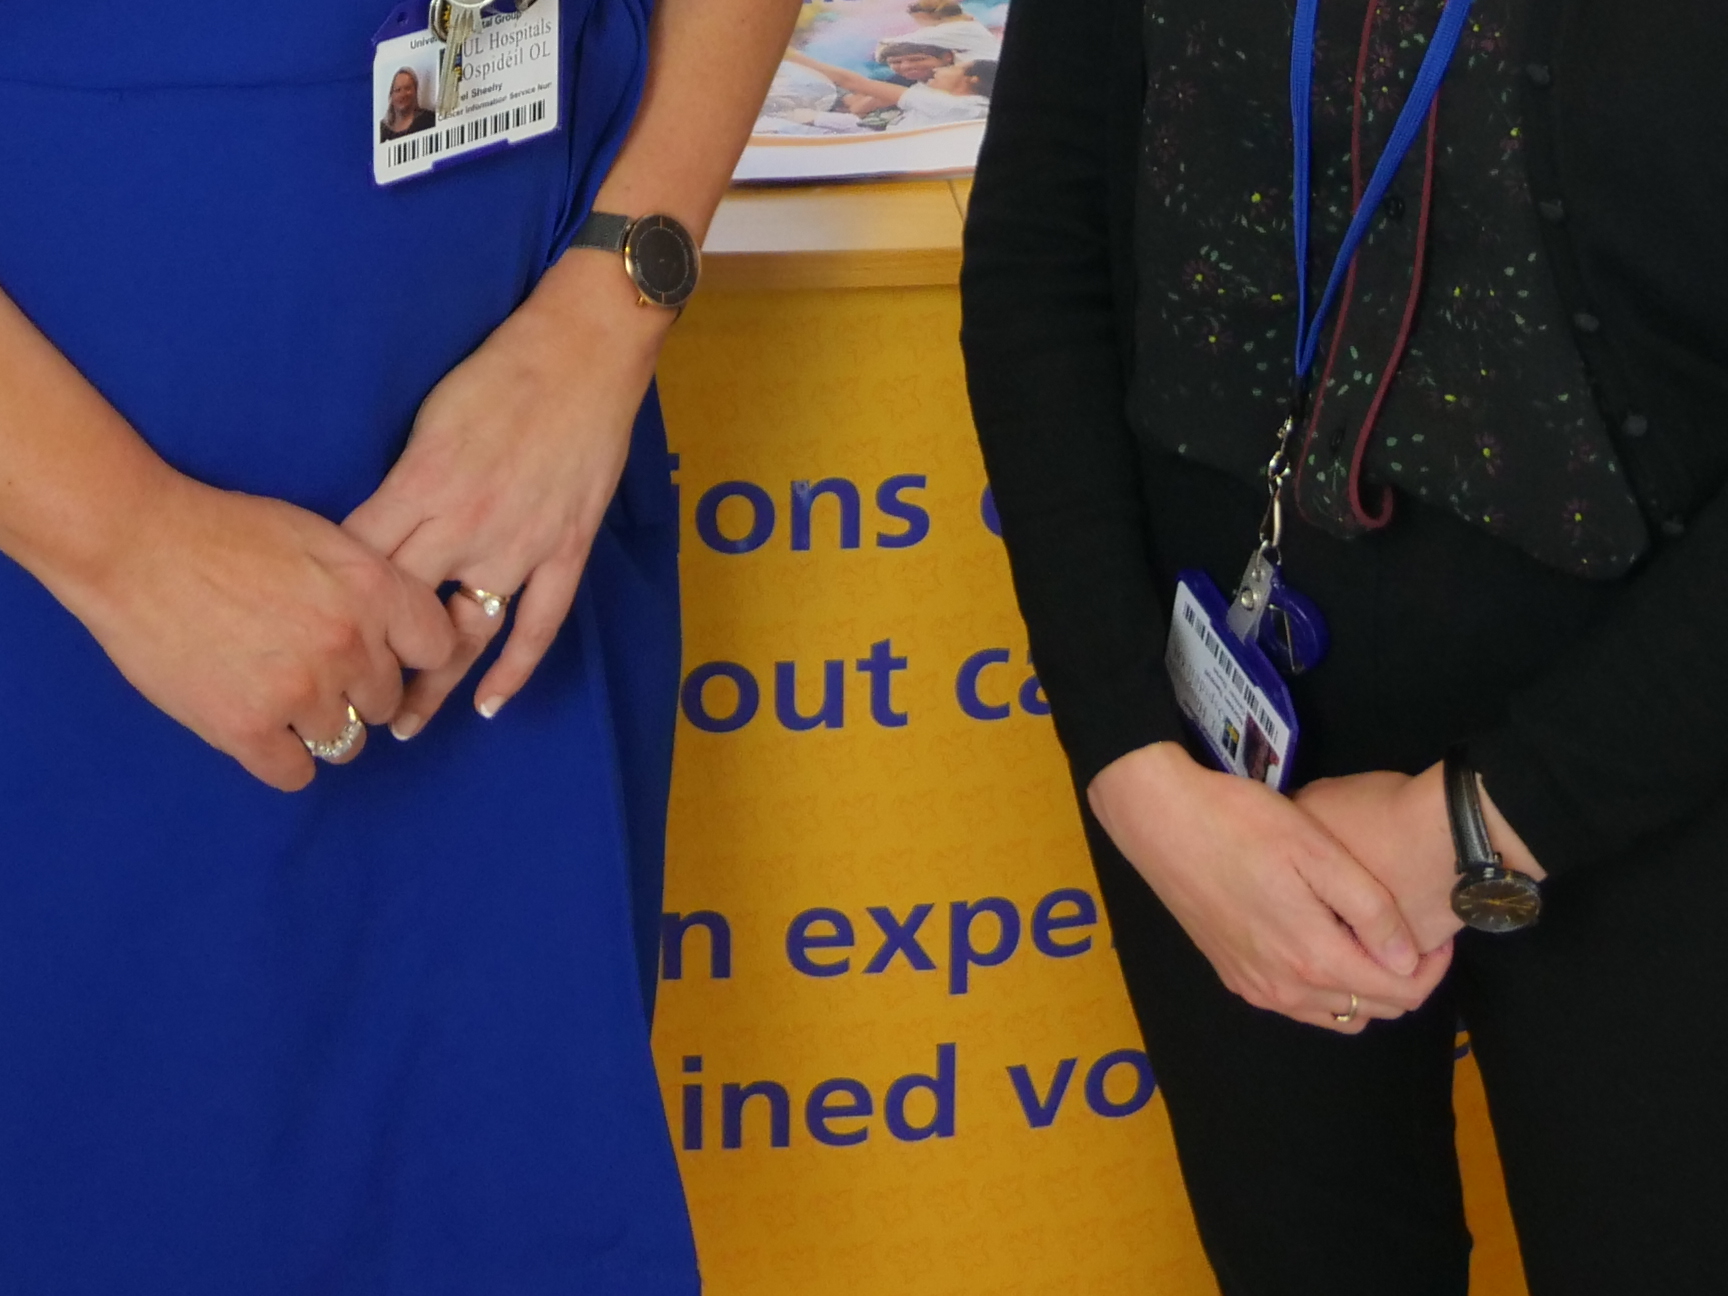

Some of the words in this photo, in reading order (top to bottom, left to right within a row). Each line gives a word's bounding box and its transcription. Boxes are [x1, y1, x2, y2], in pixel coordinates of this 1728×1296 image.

[463, 37, 484, 58] UL
[490, 18, 552, 50] Hospitals
[494, 11, 522, 26] Group
[462, 47, 523, 81] Ospidéil
[529, 41, 551, 60] OL
[681, 1042, 957, 1151] ined
